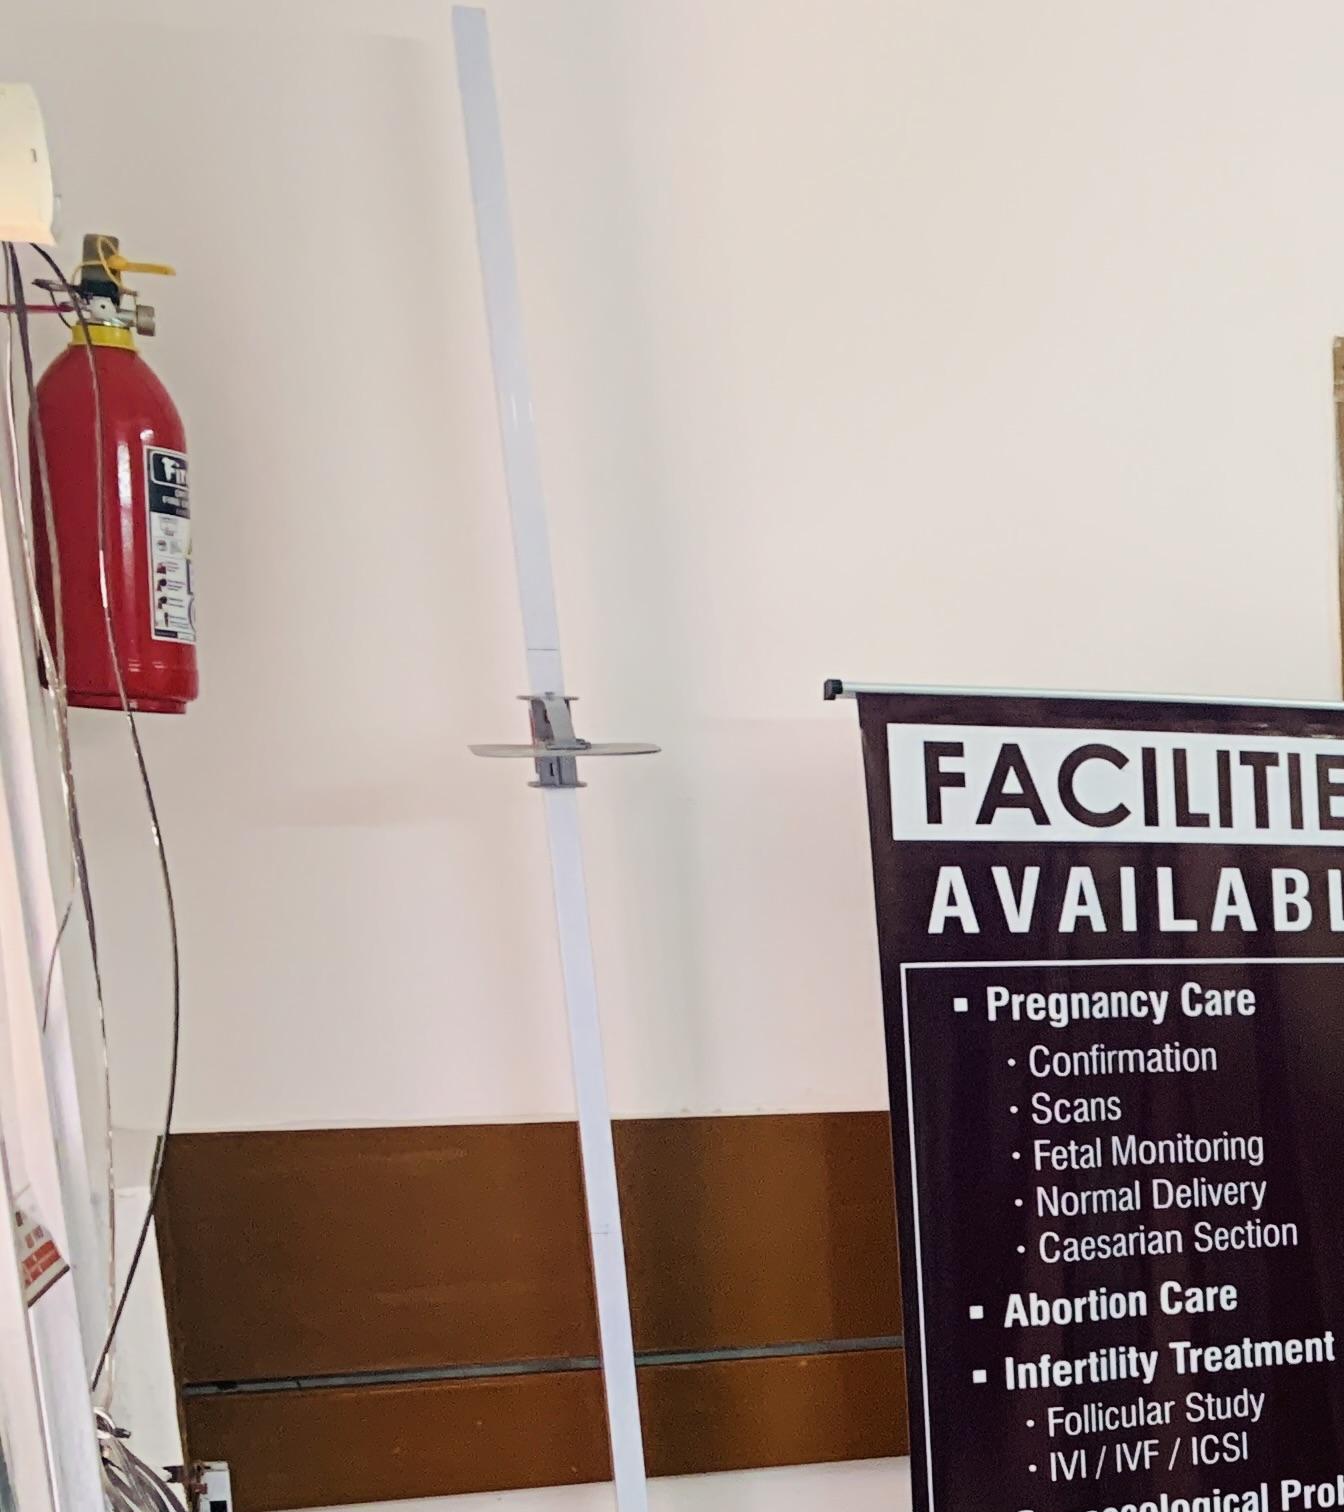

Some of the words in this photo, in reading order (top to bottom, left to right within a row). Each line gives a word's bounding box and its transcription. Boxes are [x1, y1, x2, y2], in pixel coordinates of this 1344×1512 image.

[986, 985, 1169, 1028] Pregnancy
[1180, 981, 1256, 1017] Care
[1029, 1041, 1217, 1078] Confirmation
[1031, 1091, 1122, 1125] Scans
[1033, 1137, 1102, 1171] Fetal
[1111, 1130, 1264, 1166] Monitoring
[1036, 1179, 1141, 1218] Normal
[1152, 1177, 1267, 1211] Delivery
[1039, 1224, 1183, 1264] Caesarian
[1194, 1218, 1298, 1253] Section
[1003, 1286, 1148, 1328] Abortion
[1159, 1280, 1238, 1315] Care
[1005, 1346, 1159, 1391] Infertility
[1168, 1330, 1336, 1375] Treatment
[1047, 1396, 1176, 1437] Follicular
[1185, 1387, 1265, 1423] Study
[1050, 1449, 1087, 1482] IVI
[1115, 1439, 1160, 1473] IVF
[1191, 1431, 1248, 1466] ICSI
